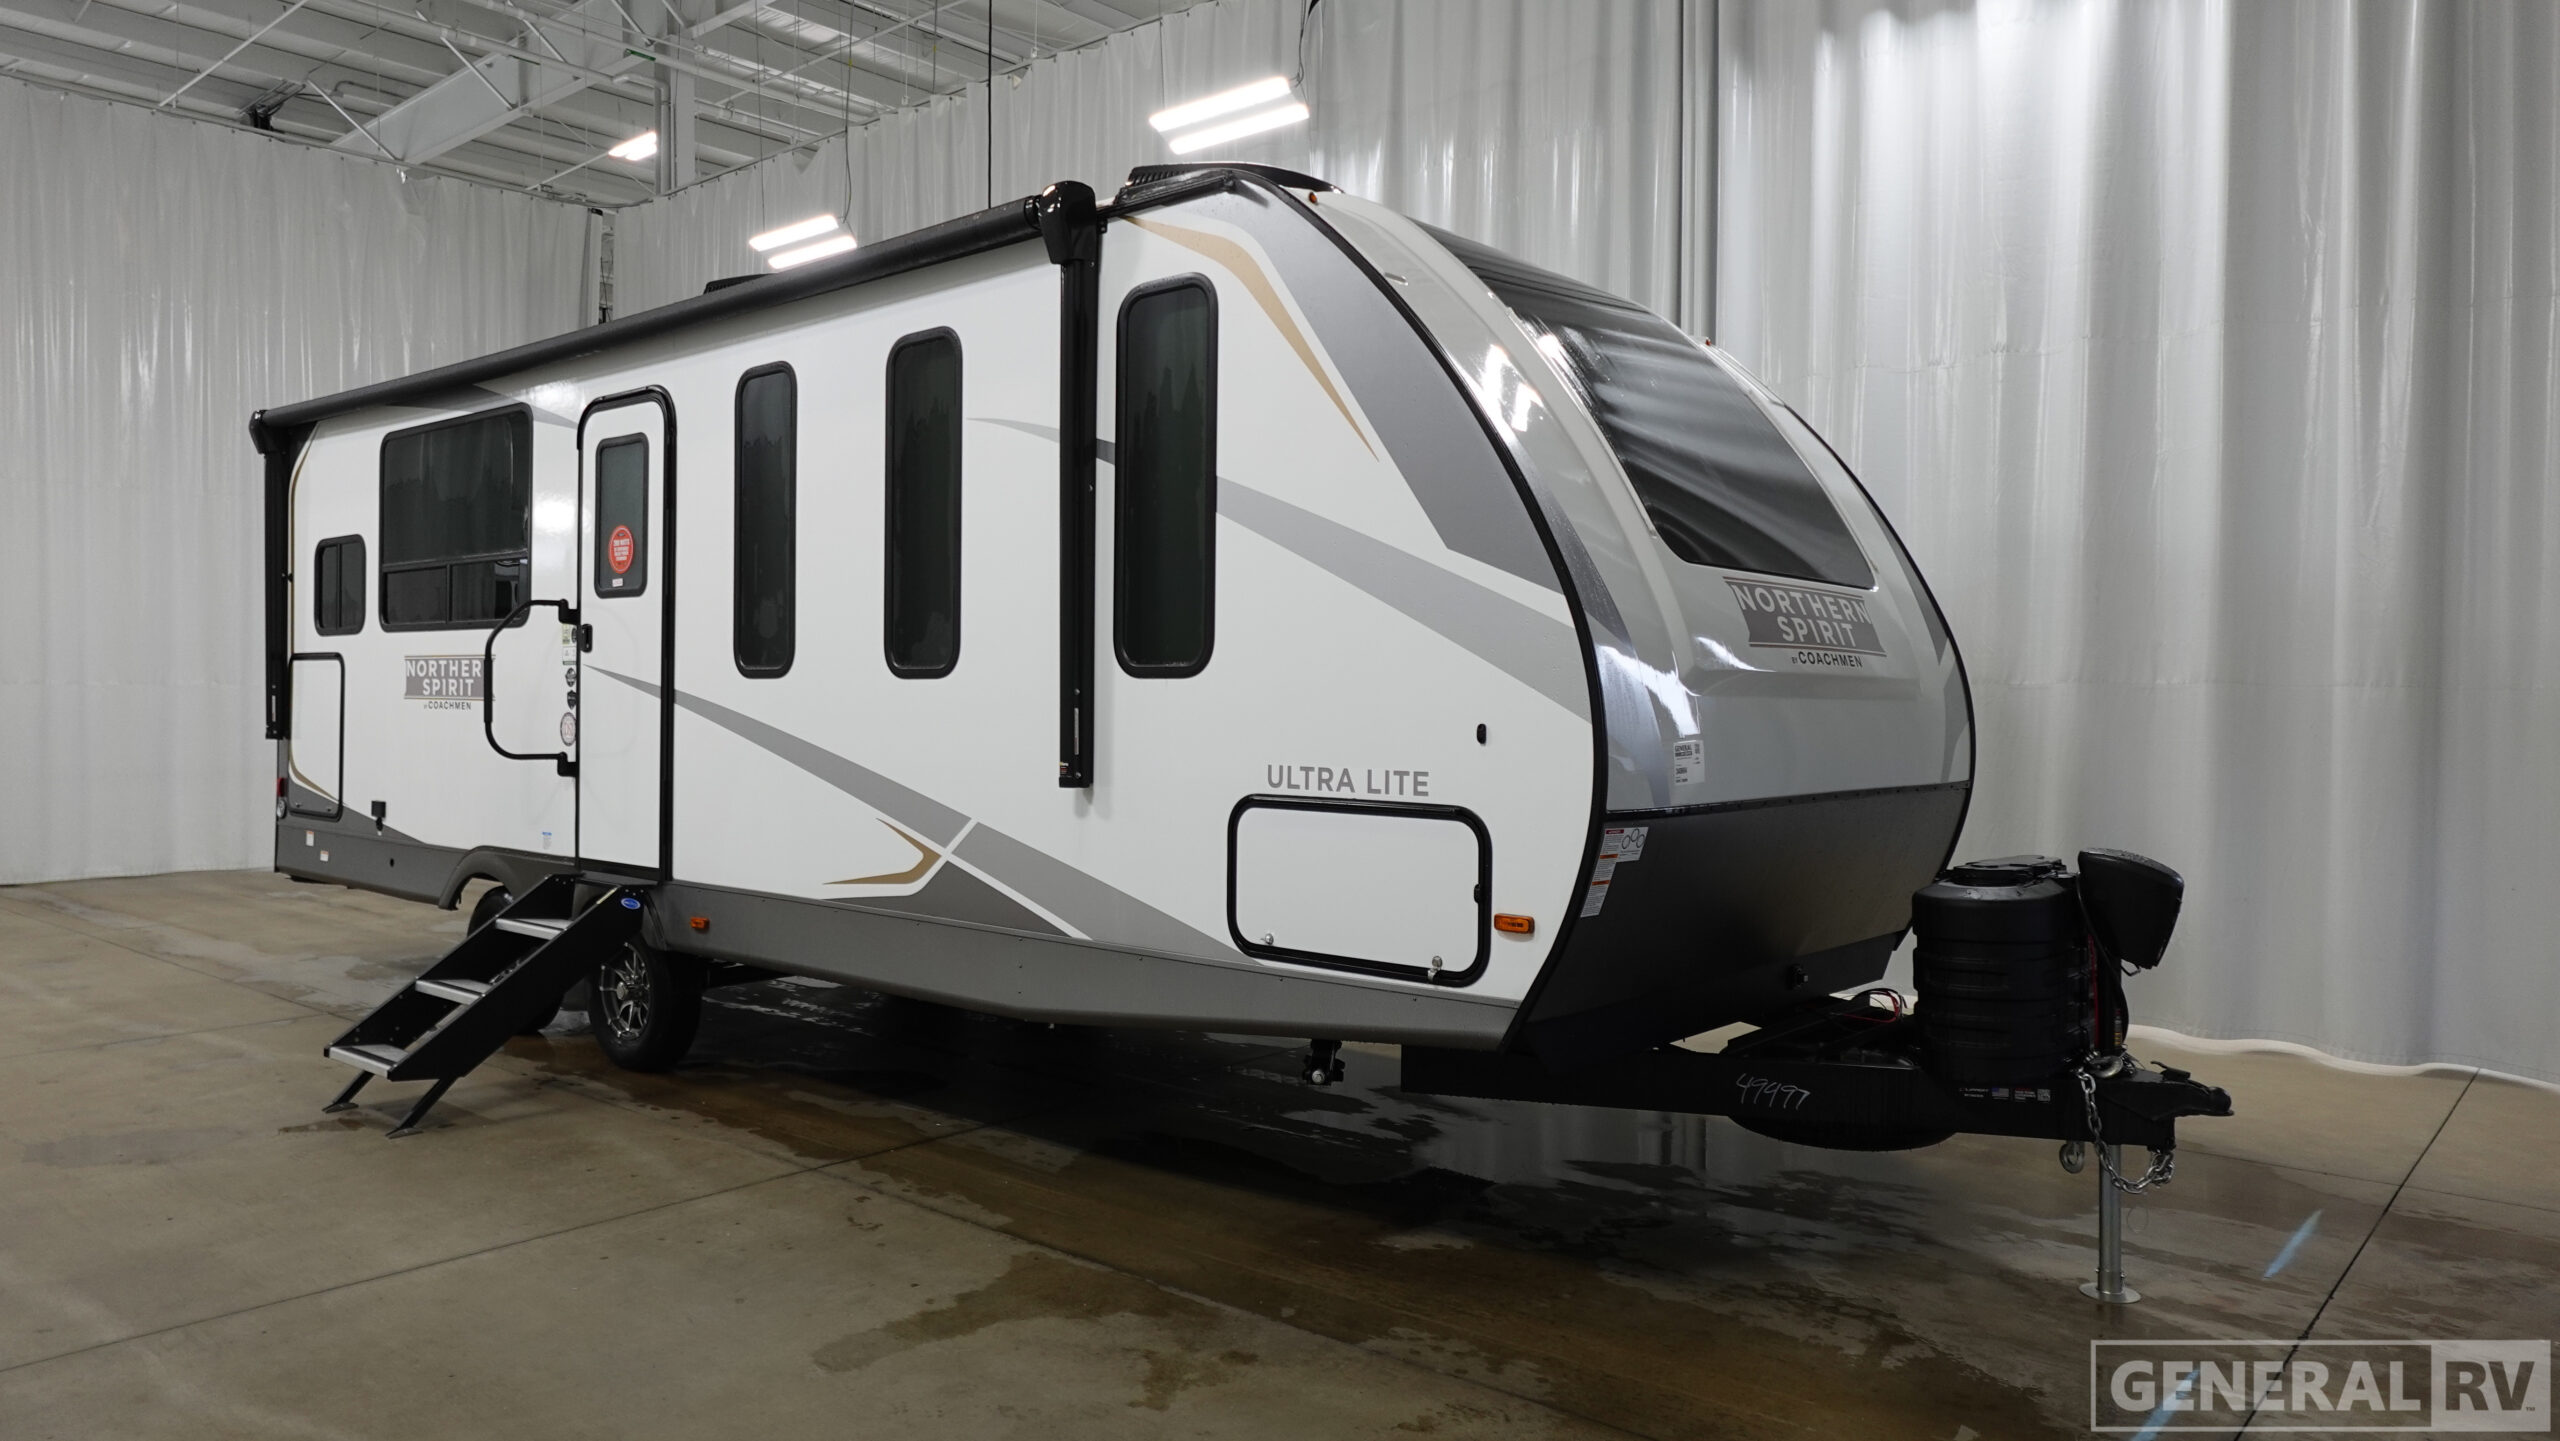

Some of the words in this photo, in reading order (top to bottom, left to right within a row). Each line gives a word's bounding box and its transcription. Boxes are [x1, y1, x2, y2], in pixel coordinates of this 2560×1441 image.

[1731, 584, 1872, 625] NORTHERN
[1777, 616, 1857, 647] SPIRIT
[407, 660, 482, 677] NORTHER
[1798, 651, 1863, 668] COACHMEN
[422, 678, 474, 696] SPIRIT
[428, 701, 472, 710] COACHMEN
[1267, 764, 1355, 793] ULTRA
[1367, 769, 1430, 796] LITE
[1736, 1073, 1811, 1111] 49497
